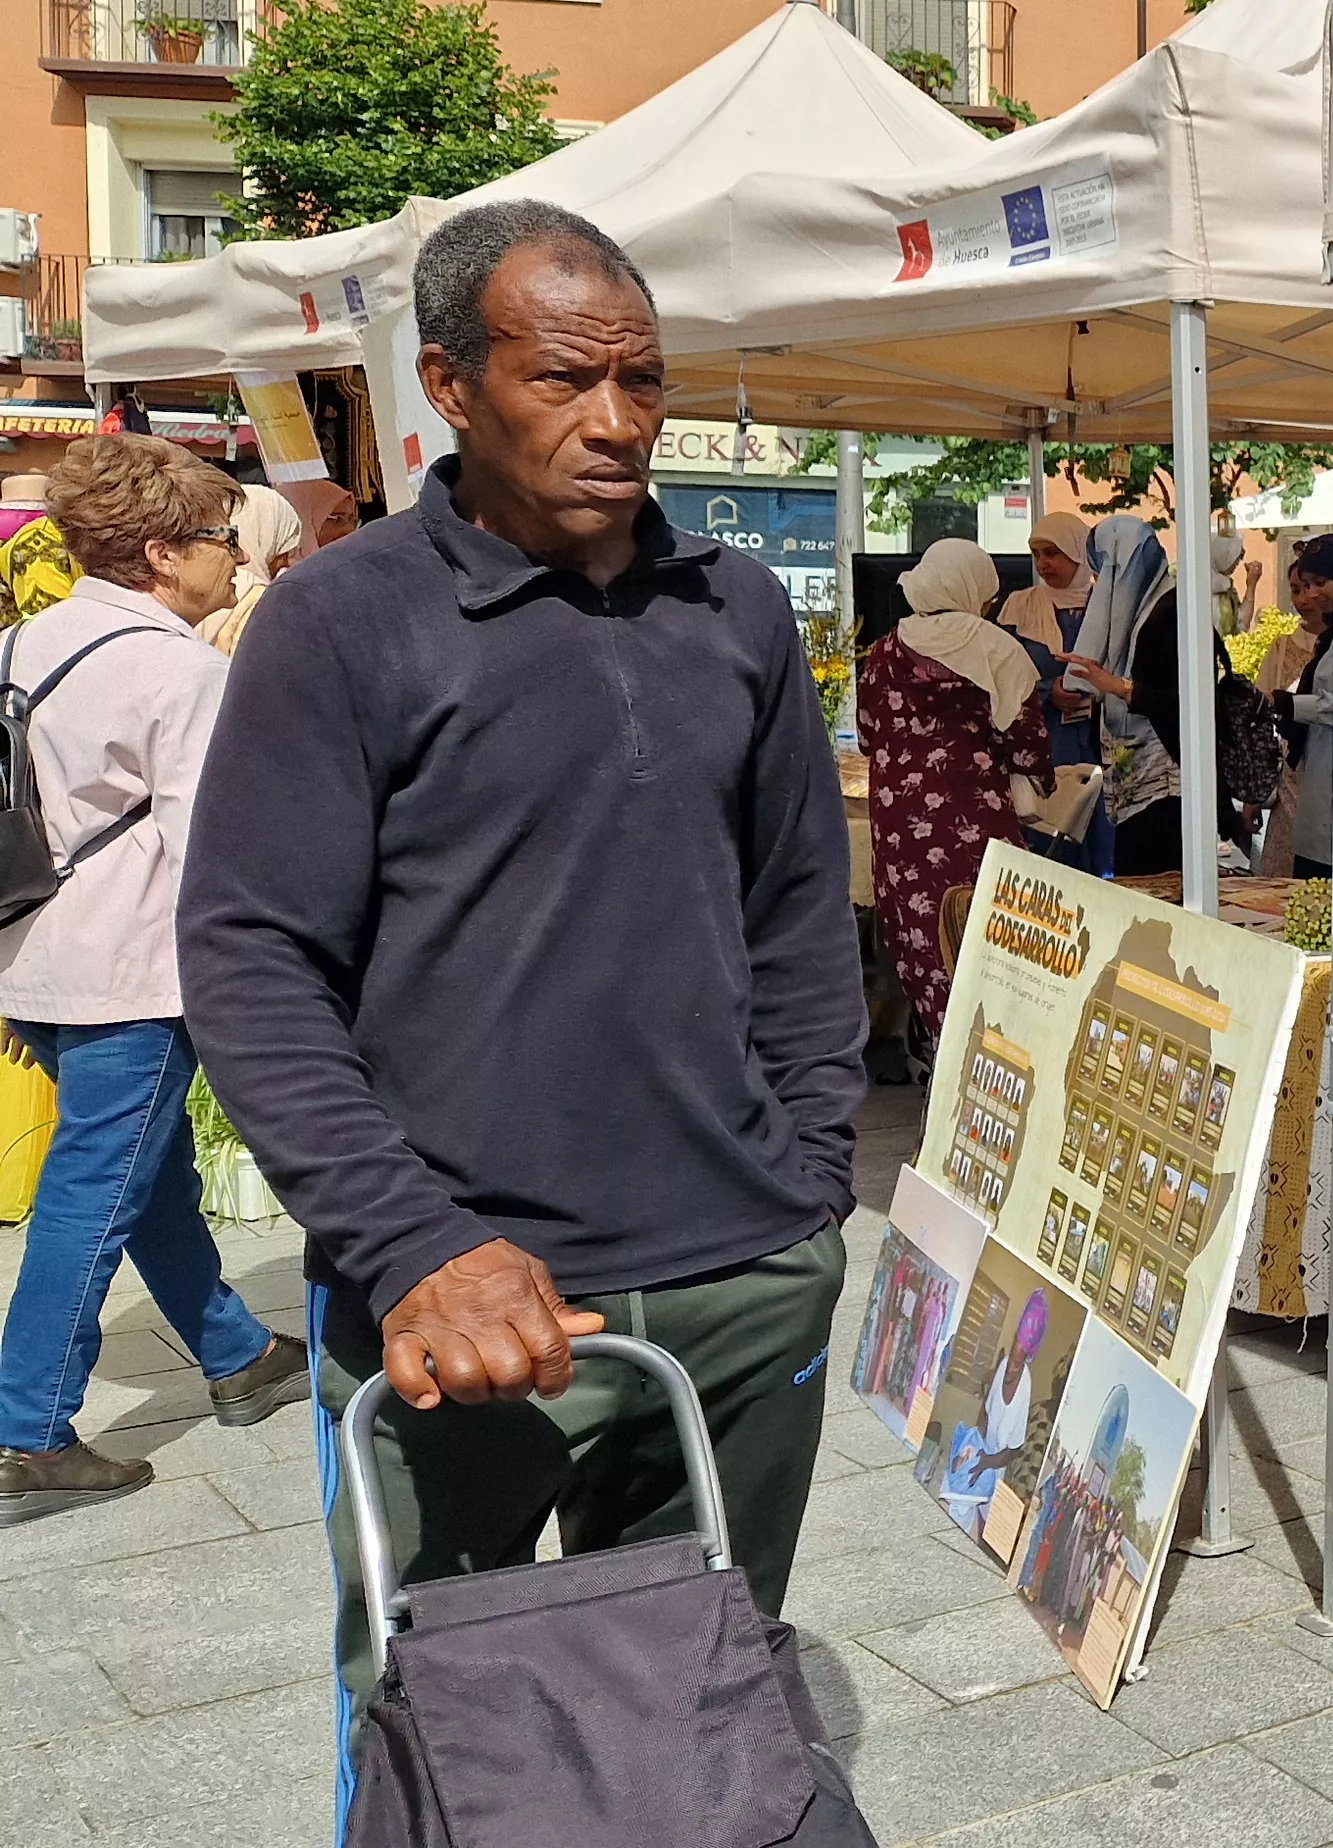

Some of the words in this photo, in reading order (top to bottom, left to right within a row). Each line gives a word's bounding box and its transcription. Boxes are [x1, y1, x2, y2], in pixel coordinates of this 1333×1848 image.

[936, 219, 1000, 248] Ayuntamiento
[938, 254, 951, 267] de
[953, 245, 989, 265] Huesca
[656, 431, 731, 461] ECK
[744, 434, 767, 462] &
[687, 530, 764, 549] ASCO
[801, 541, 817, 551] 722
[993, 867, 1020, 910] LAS
[1018, 877, 1063, 928] CARAS
[1058, 910, 1074, 936] DEL
[985, 910, 1077, 979] CODESARROLLO
